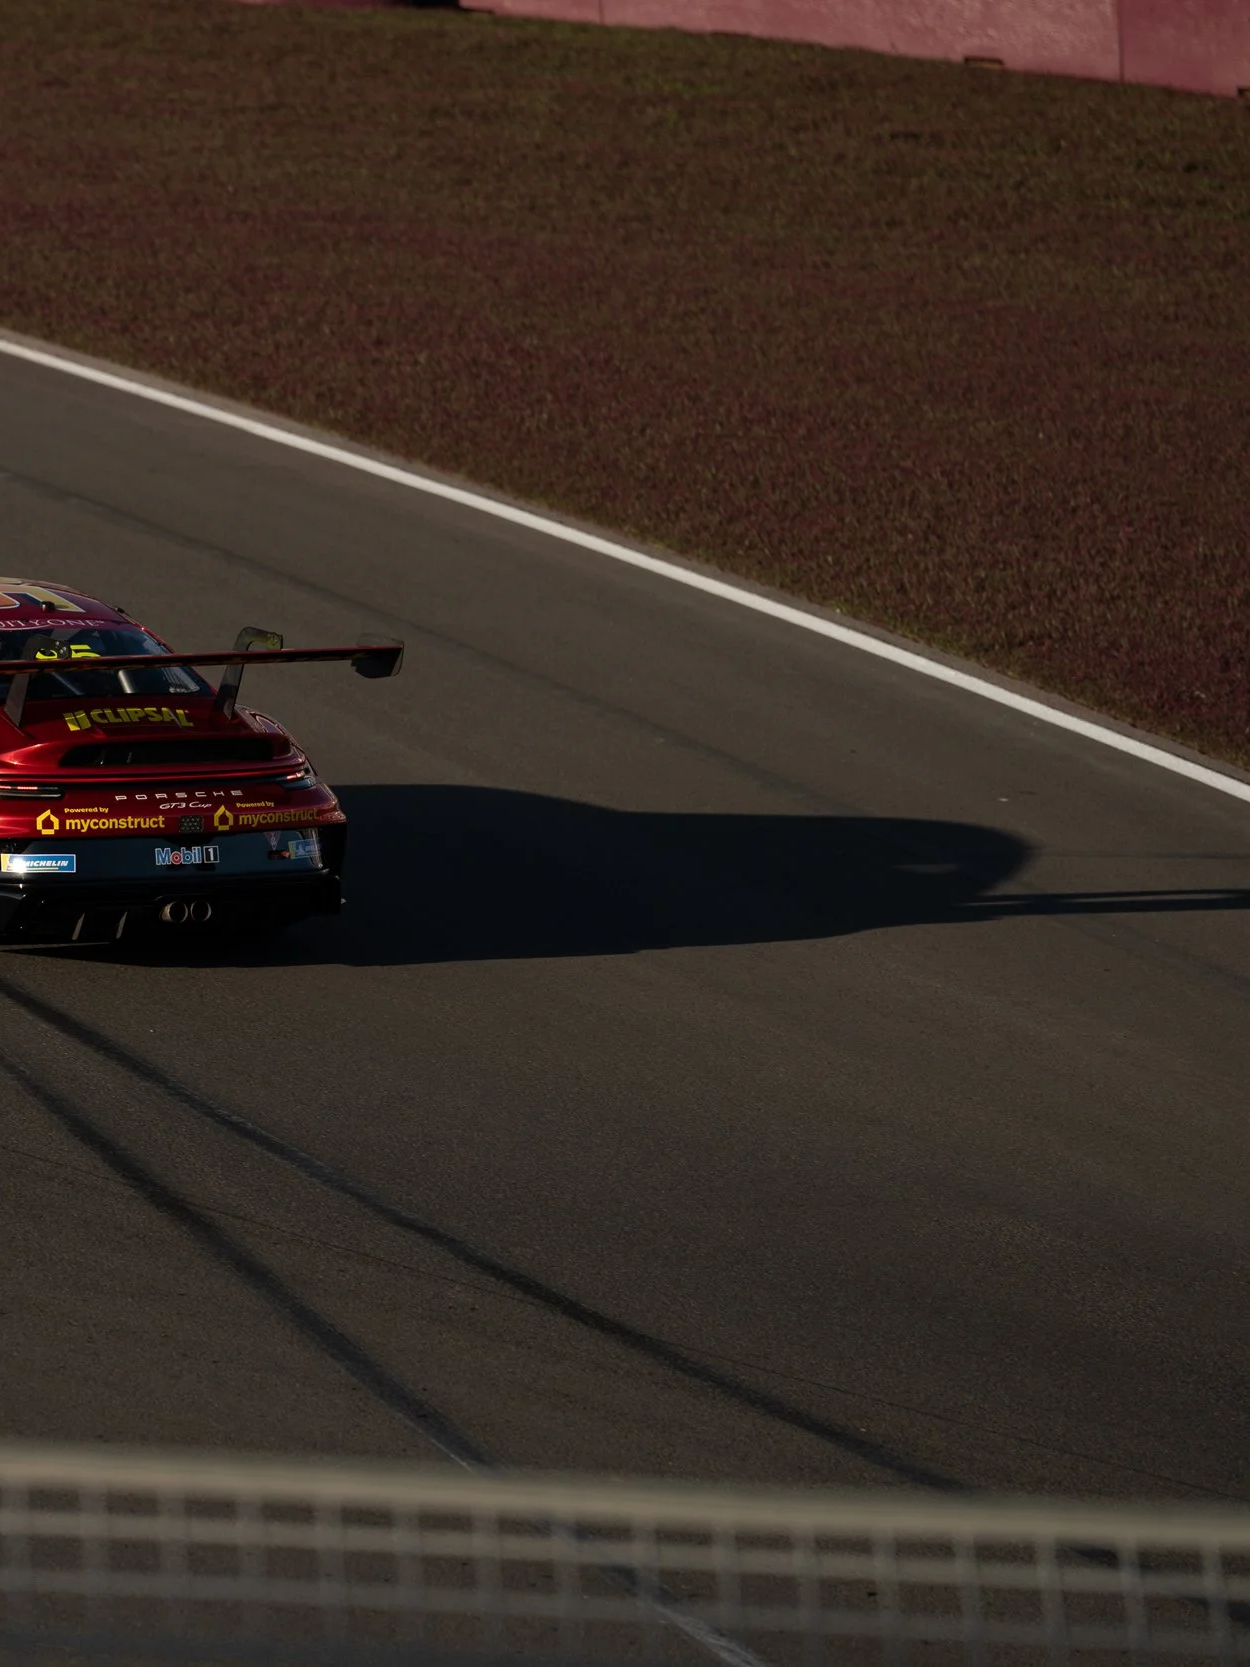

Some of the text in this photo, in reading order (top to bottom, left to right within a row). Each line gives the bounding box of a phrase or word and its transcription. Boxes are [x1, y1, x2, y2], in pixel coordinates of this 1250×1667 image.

[90, 707, 195, 727] CLIPSAL
[114, 789, 244, 801] PORSCHE
[99, 806, 109, 814] by
[159, 801, 212, 810] GT3 Cup
[65, 815, 166, 832] myconstruct
[239, 808, 319, 827] myconstruct
[155, 846, 202, 865] Mobil
